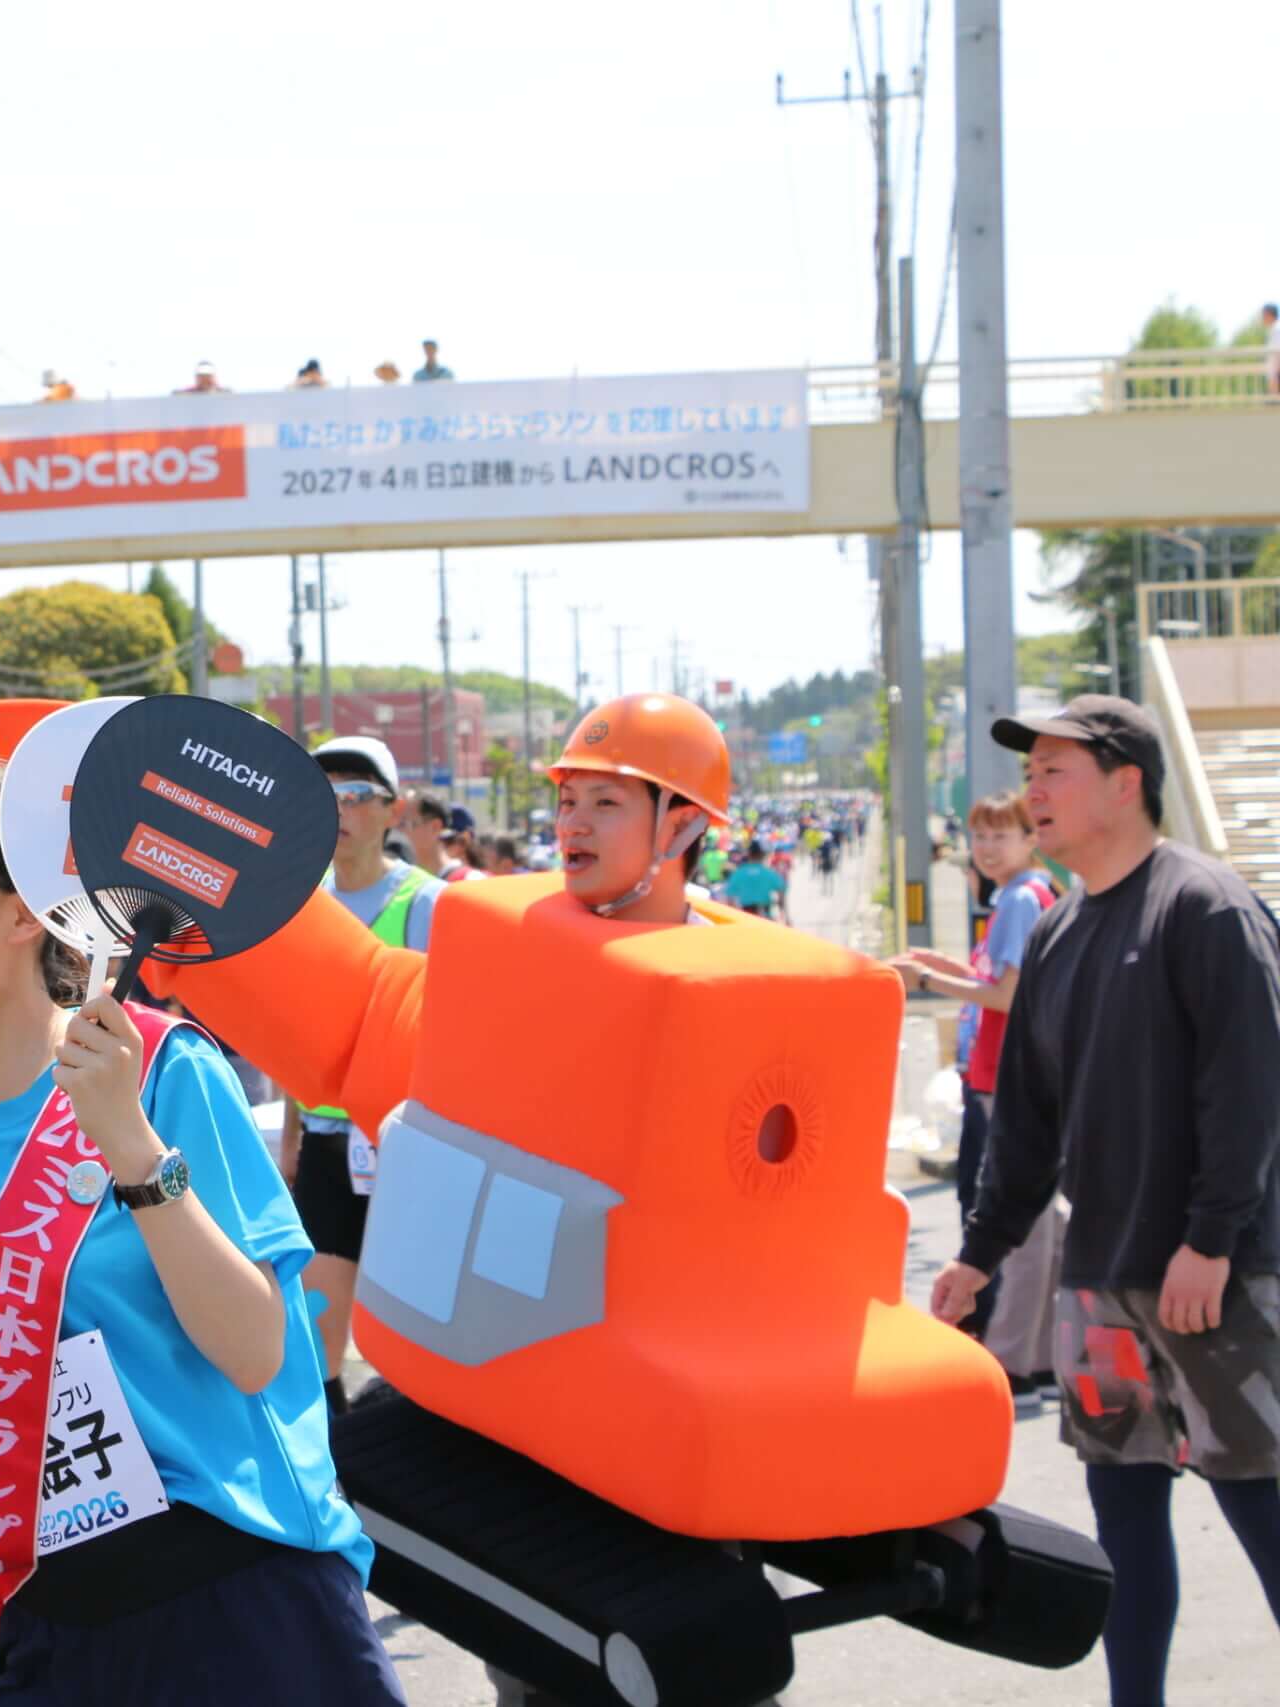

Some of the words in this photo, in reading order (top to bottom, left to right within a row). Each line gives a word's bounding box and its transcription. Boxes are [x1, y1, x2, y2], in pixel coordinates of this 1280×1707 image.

[181, 738, 275, 798] HITACHI
[157, 780, 202, 811] Reliable
[204, 803, 257, 840] Solutions
[135, 839, 224, 893] LANDCROS
[56, 1489, 129, 1540] 2026
